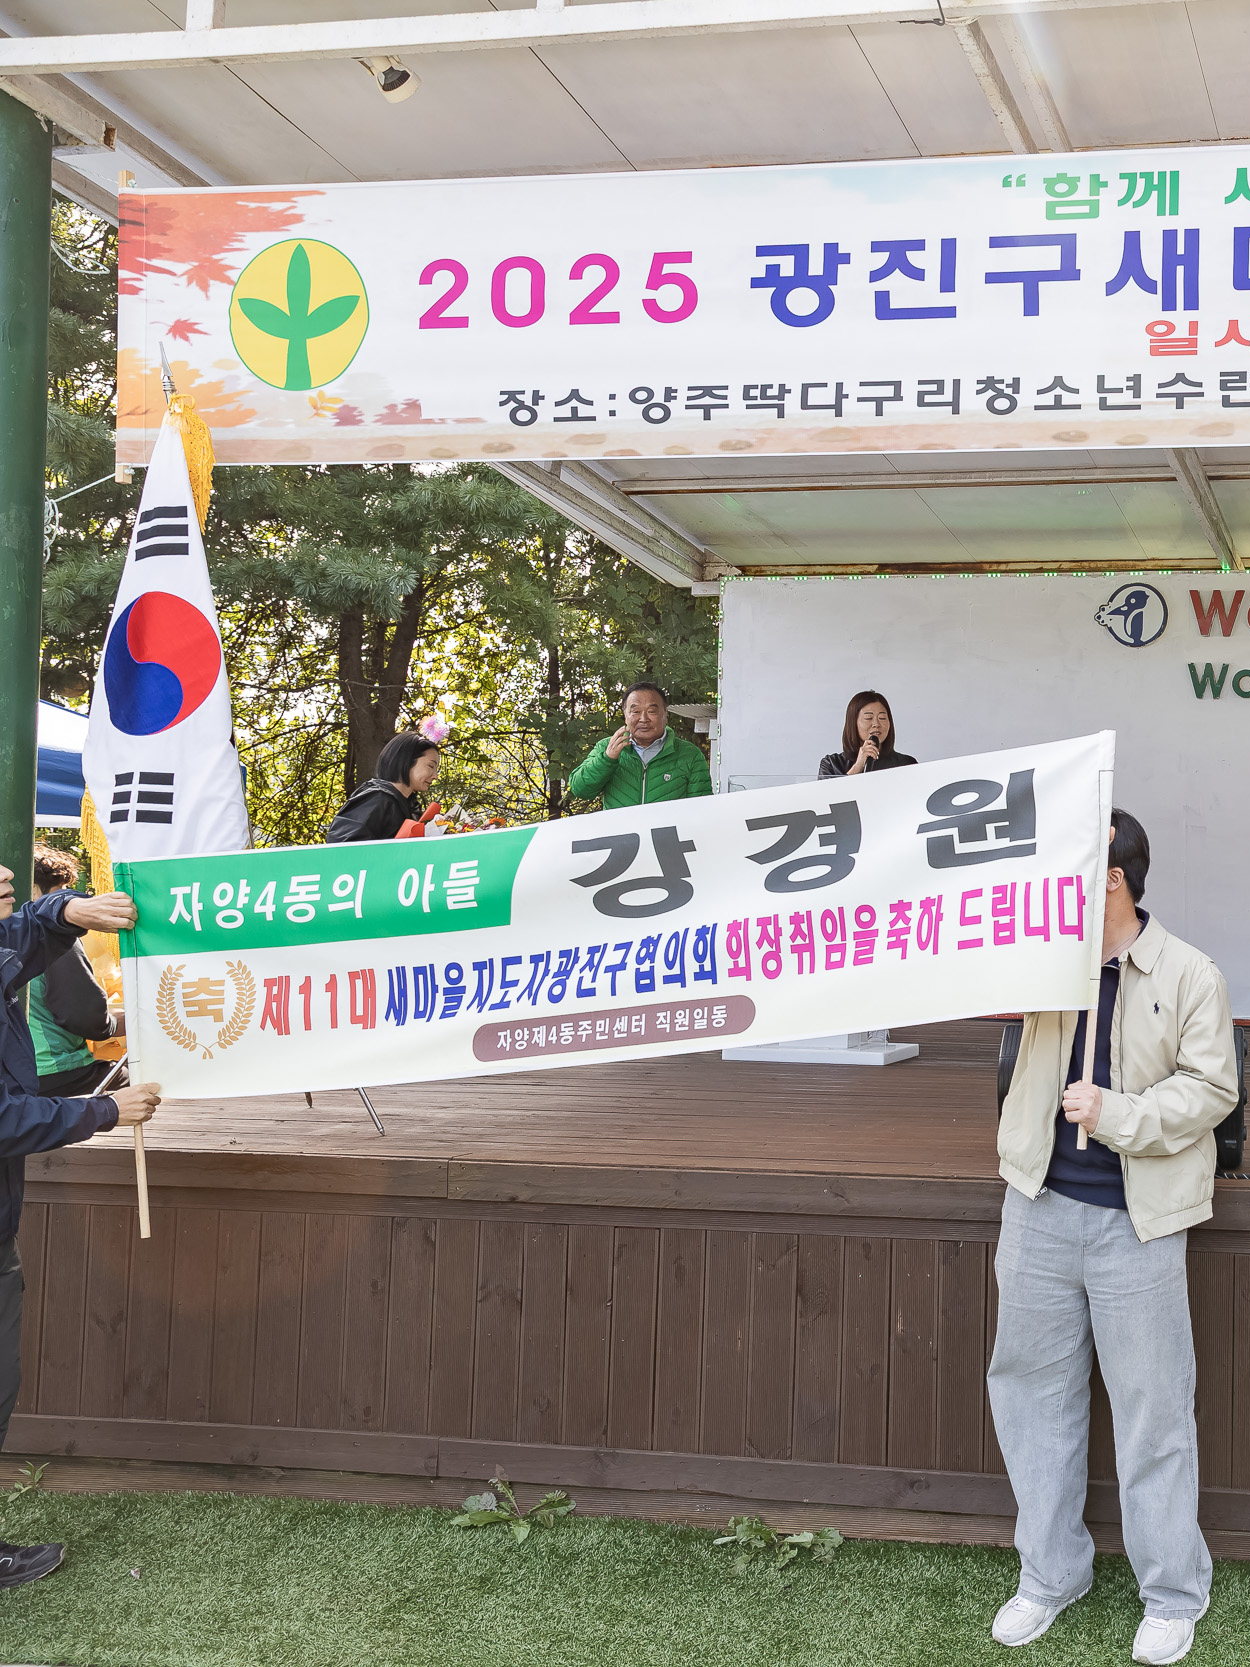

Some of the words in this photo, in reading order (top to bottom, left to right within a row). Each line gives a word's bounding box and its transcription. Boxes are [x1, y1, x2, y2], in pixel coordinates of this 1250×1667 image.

[418, 250, 699, 330] 2025
[168, 870, 367, 932] 자양4동의
[397, 859, 481, 913] 아들
[259, 968, 377, 1036] 제11대
[957, 874, 1086, 951] 드립니다
[181, 977, 226, 1023] 축
[496, 1013, 647, 1052] 자양제4동주민센터
[655, 1004, 729, 1034] 직원일동
